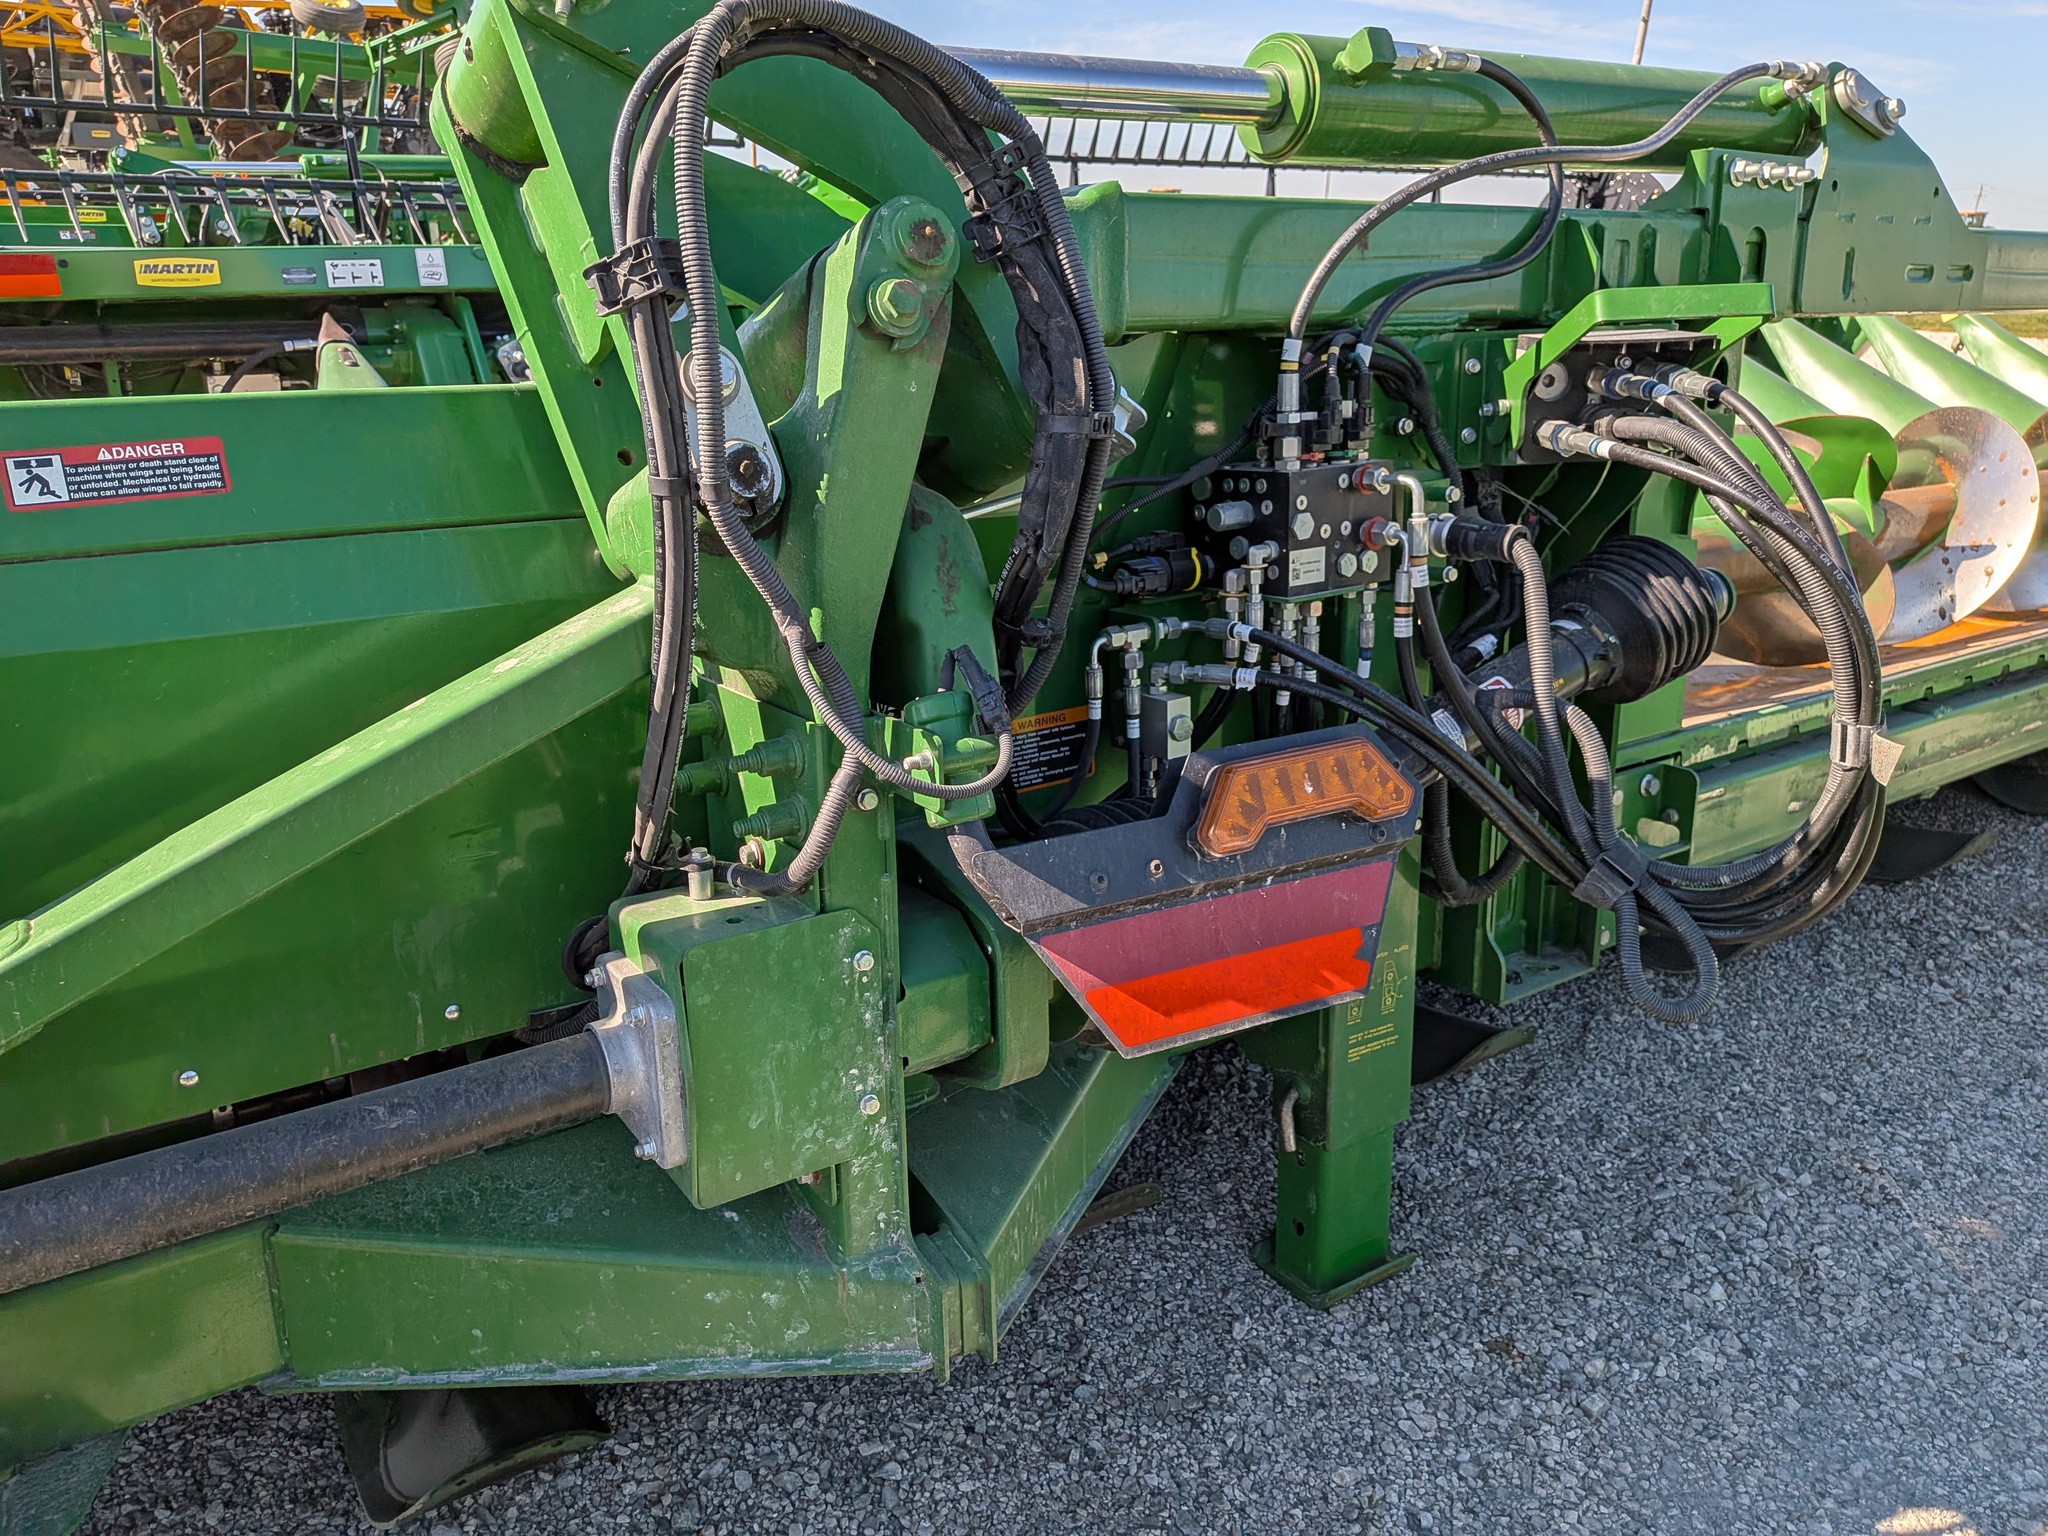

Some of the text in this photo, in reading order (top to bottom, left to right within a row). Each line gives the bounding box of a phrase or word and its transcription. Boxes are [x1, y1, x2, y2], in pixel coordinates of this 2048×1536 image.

[142, 263, 215, 274] MARTIN
[112, 442, 185, 459] DANGER
[67, 474, 103, 482] machine
[129, 469, 153, 477] wings
[170, 465, 193, 474] being
[77, 465, 100, 473] avoid
[103, 463, 126, 471] injury
[164, 458, 186, 466] stand
[81, 481, 121, 489] unfolded.
[123, 476, 170, 486] Mechanical
[183, 472, 221, 481] hydraulic
[70, 491, 98, 499] failure
[142, 485, 167, 494] wings
[194, 480, 224, 489] rapidly.
[1718, 509, 1728, 520] EN
[1755, 500, 1770, 511] EN
[1772, 510, 1791, 526] 857
[1793, 527, 1810, 544] 1SC
[1820, 553, 1832, 567] DN
[1833, 569, 1843, 581] 10
[1017, 713, 1066, 730] WARNING
